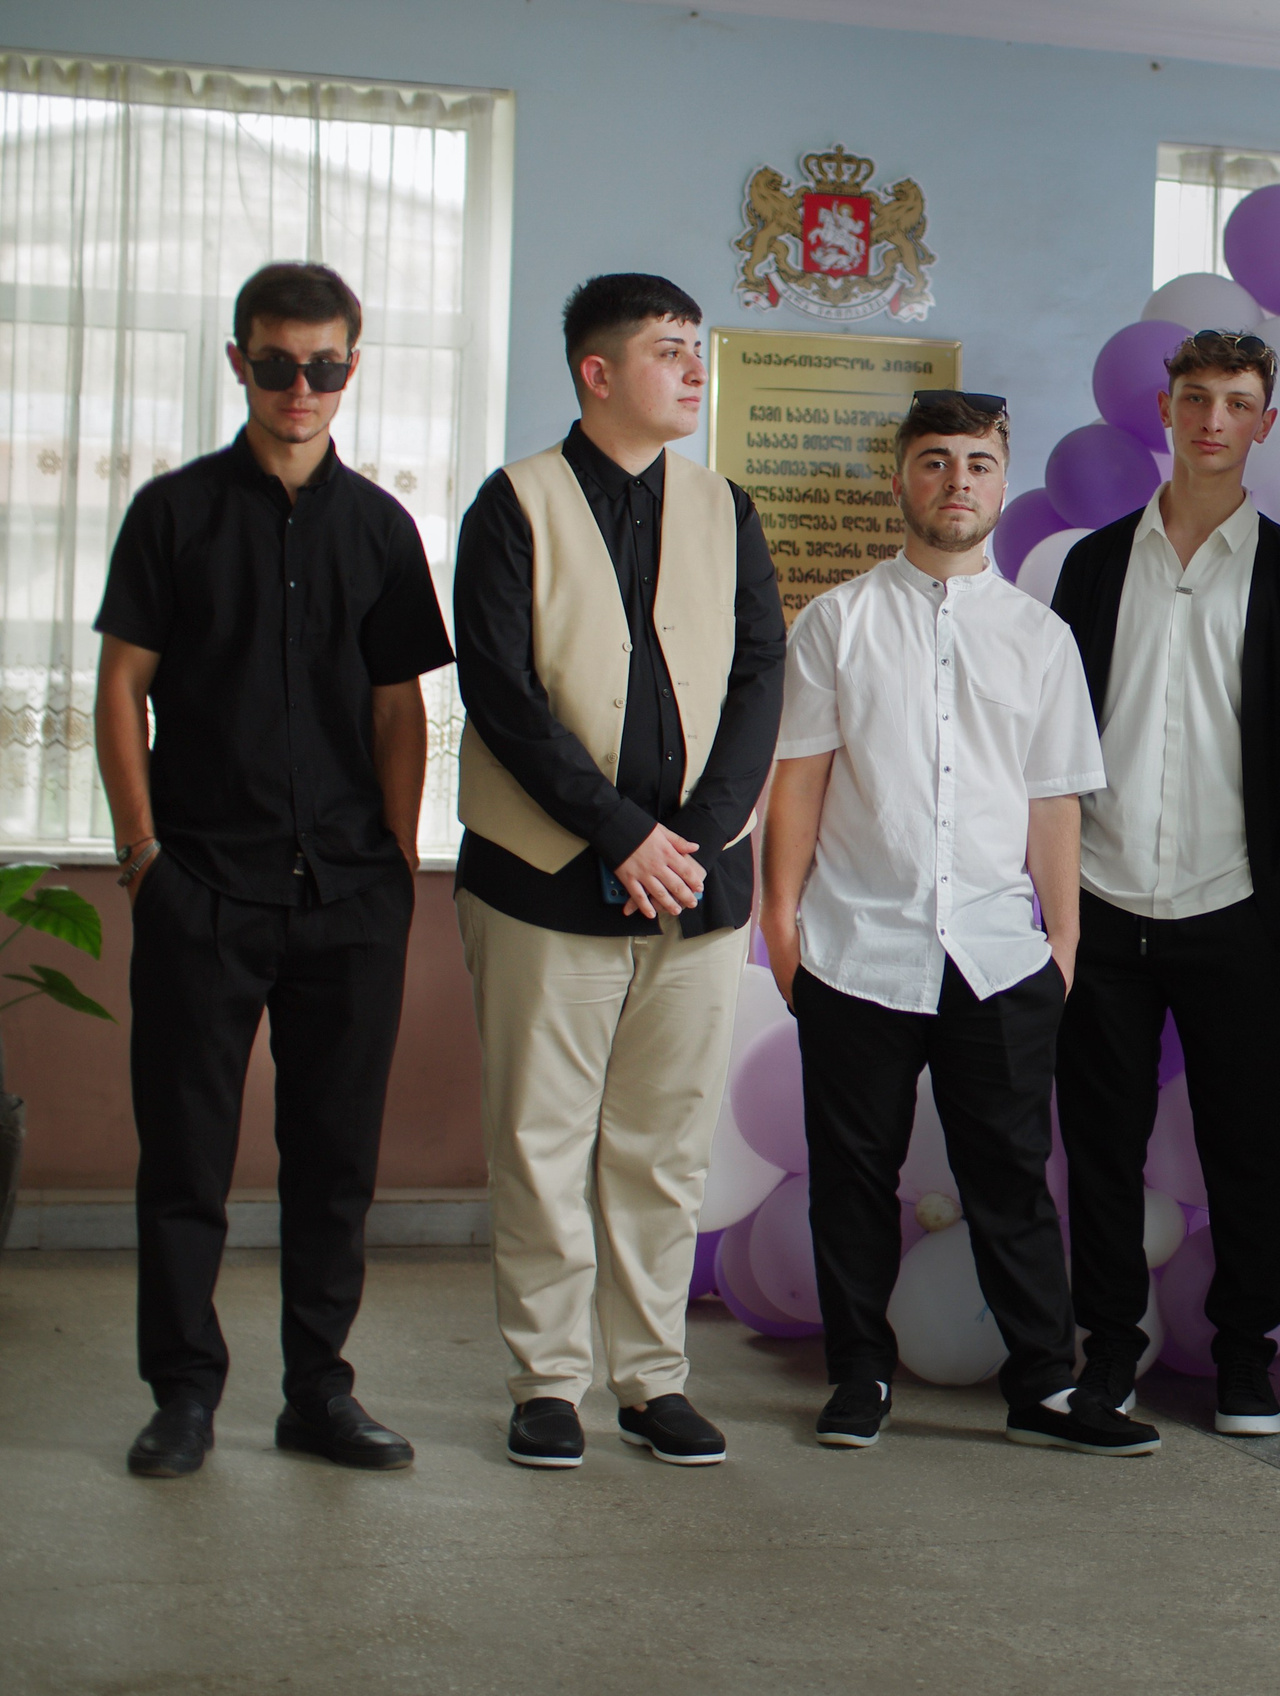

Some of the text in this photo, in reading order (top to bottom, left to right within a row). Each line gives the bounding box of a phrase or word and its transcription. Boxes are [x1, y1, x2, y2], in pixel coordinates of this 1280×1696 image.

[742, 351, 933, 374] საქართველოს ჰიმნი
[750, 405, 782, 421] ჩემი
[787, 406, 829, 424] ხატია
[747, 431, 798, 449] სახატე
[803, 433, 852, 451] მთელი
[745, 458, 841, 478] განათებული
[842, 515, 881, 533] დღეს
[806, 541, 861, 558] უმღერს
